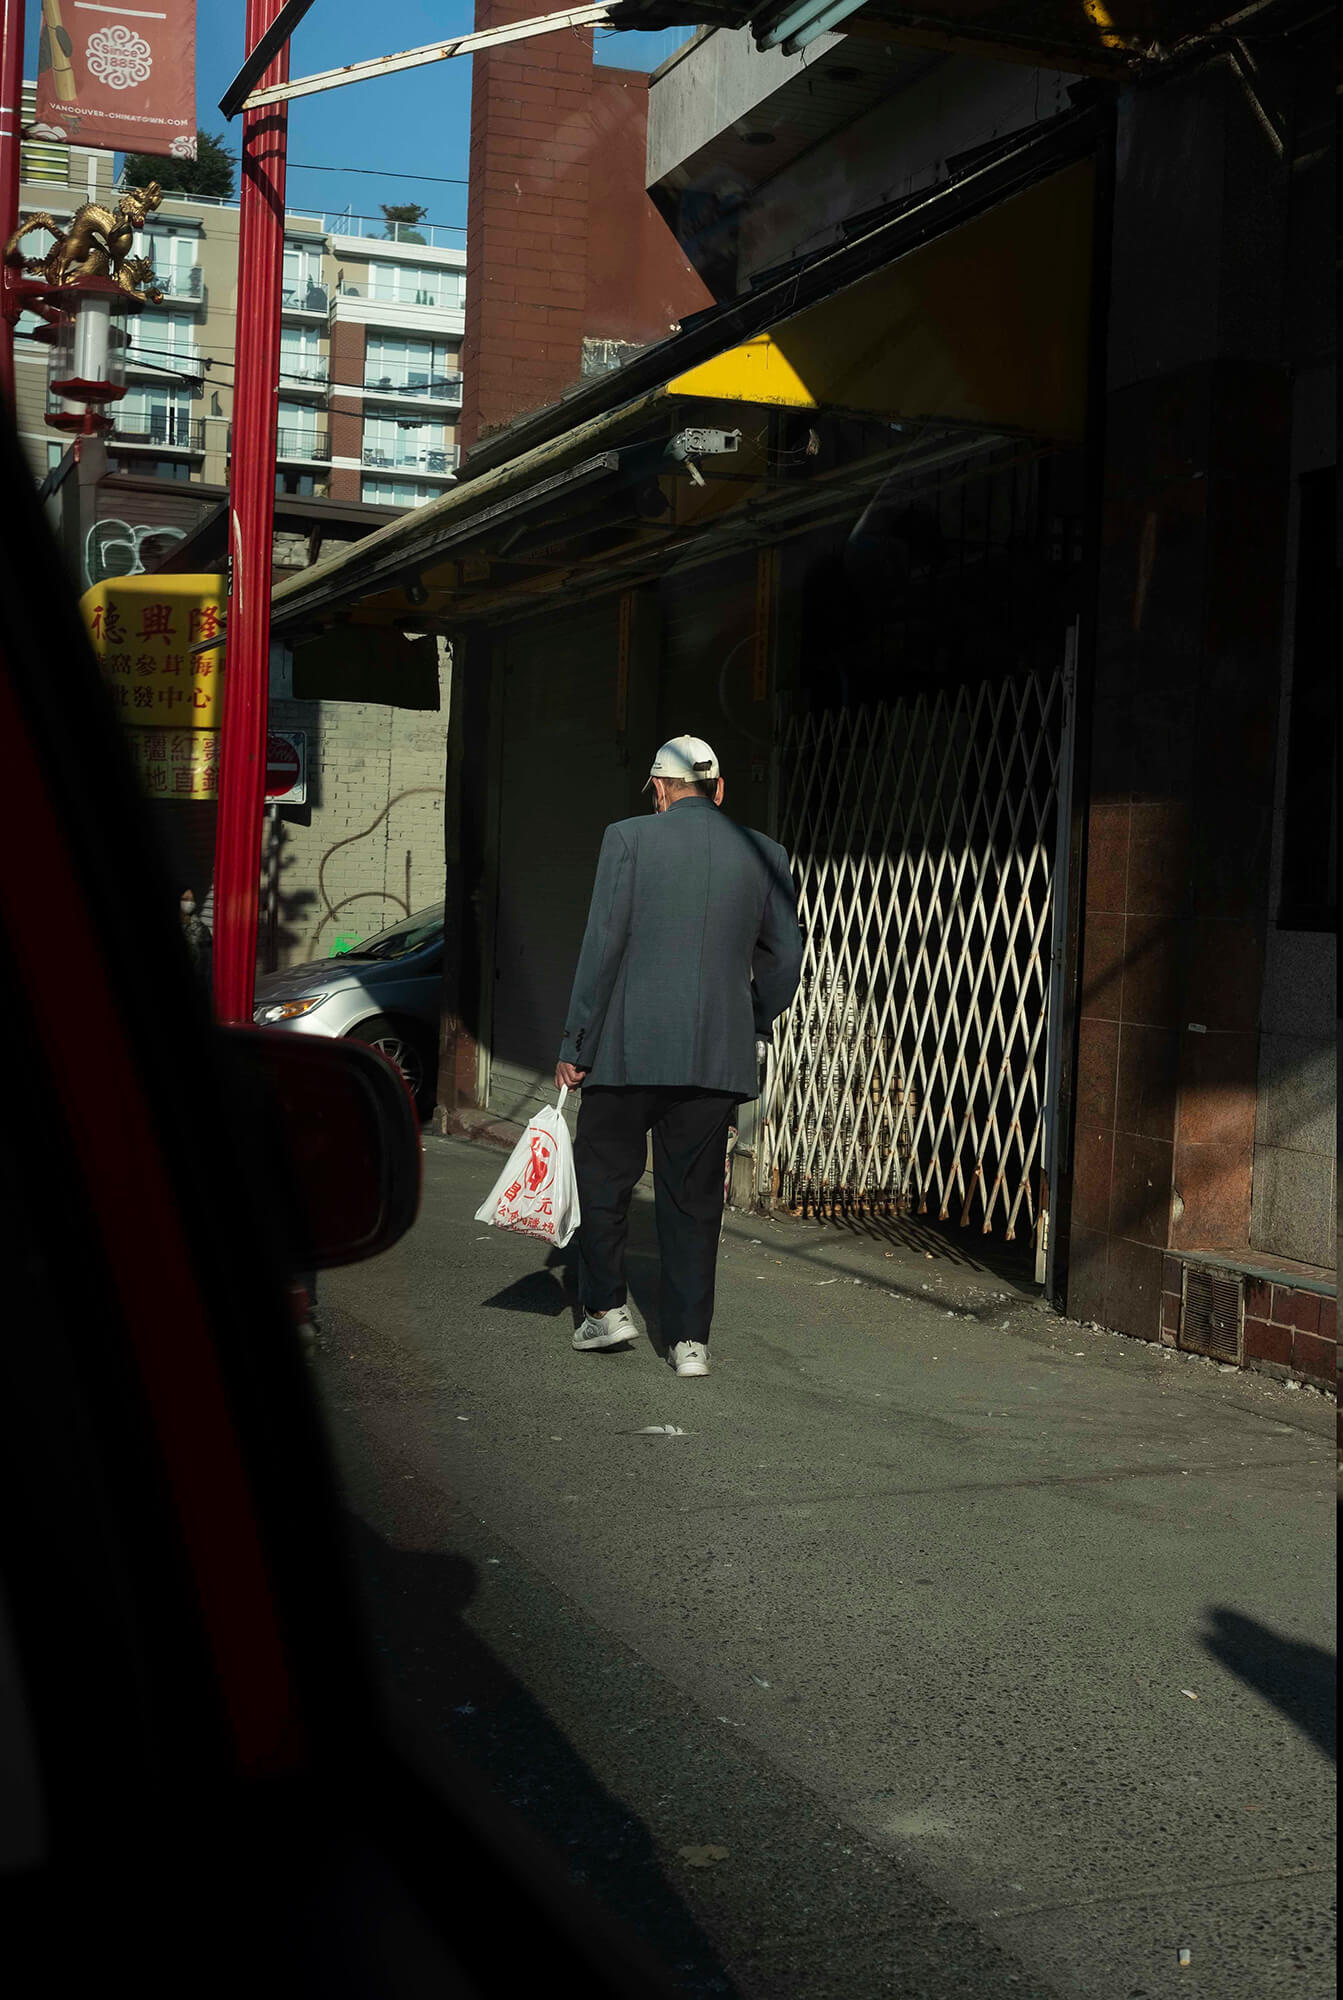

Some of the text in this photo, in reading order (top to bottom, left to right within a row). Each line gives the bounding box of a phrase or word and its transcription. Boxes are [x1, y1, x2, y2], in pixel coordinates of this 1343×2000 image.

[101, 44, 138, 58] Since
[103, 56, 137, 69] 1885
[49, 103, 188, 126] VANCOUVER-CHINATOWN.COM
[91, 602, 227, 646] 德興隆
